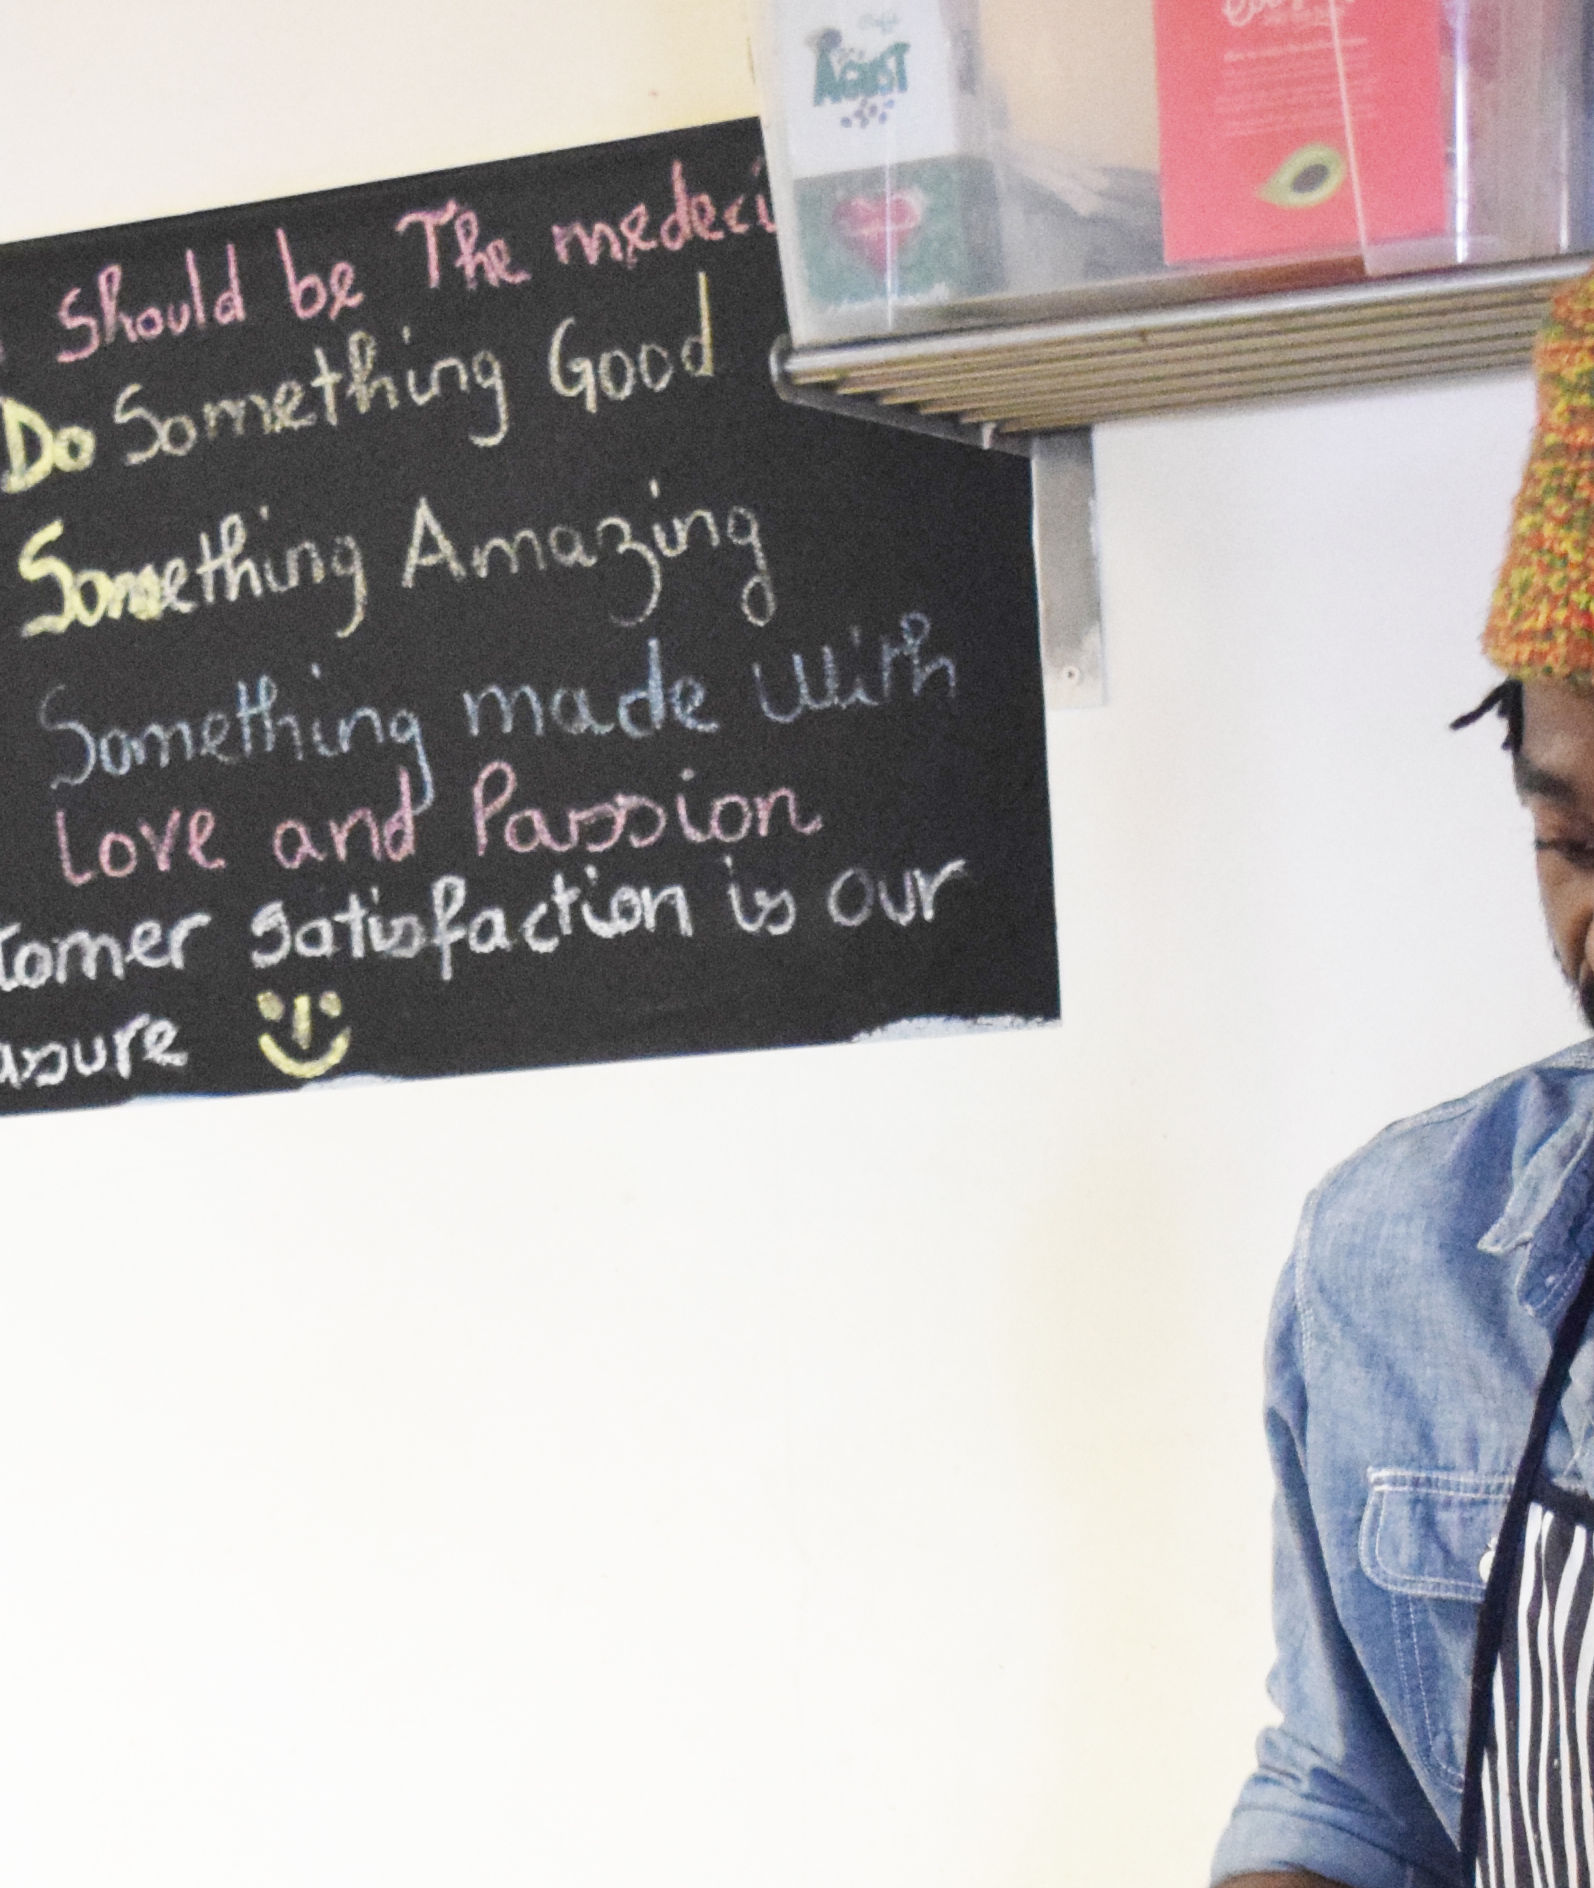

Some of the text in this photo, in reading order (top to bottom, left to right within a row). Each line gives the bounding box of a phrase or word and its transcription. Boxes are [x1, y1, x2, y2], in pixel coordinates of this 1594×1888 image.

[275, 227, 366, 322] be
[396, 202, 532, 288] The
[113, 325, 511, 450] Something
[547, 270, 714, 412] Good
[18, 478, 775, 640] Something Amazing
[38, 662, 436, 817] Something
[463, 637, 720, 739] made
[54, 760, 825, 888] Love and Passion
[722, 854, 797, 936] is
